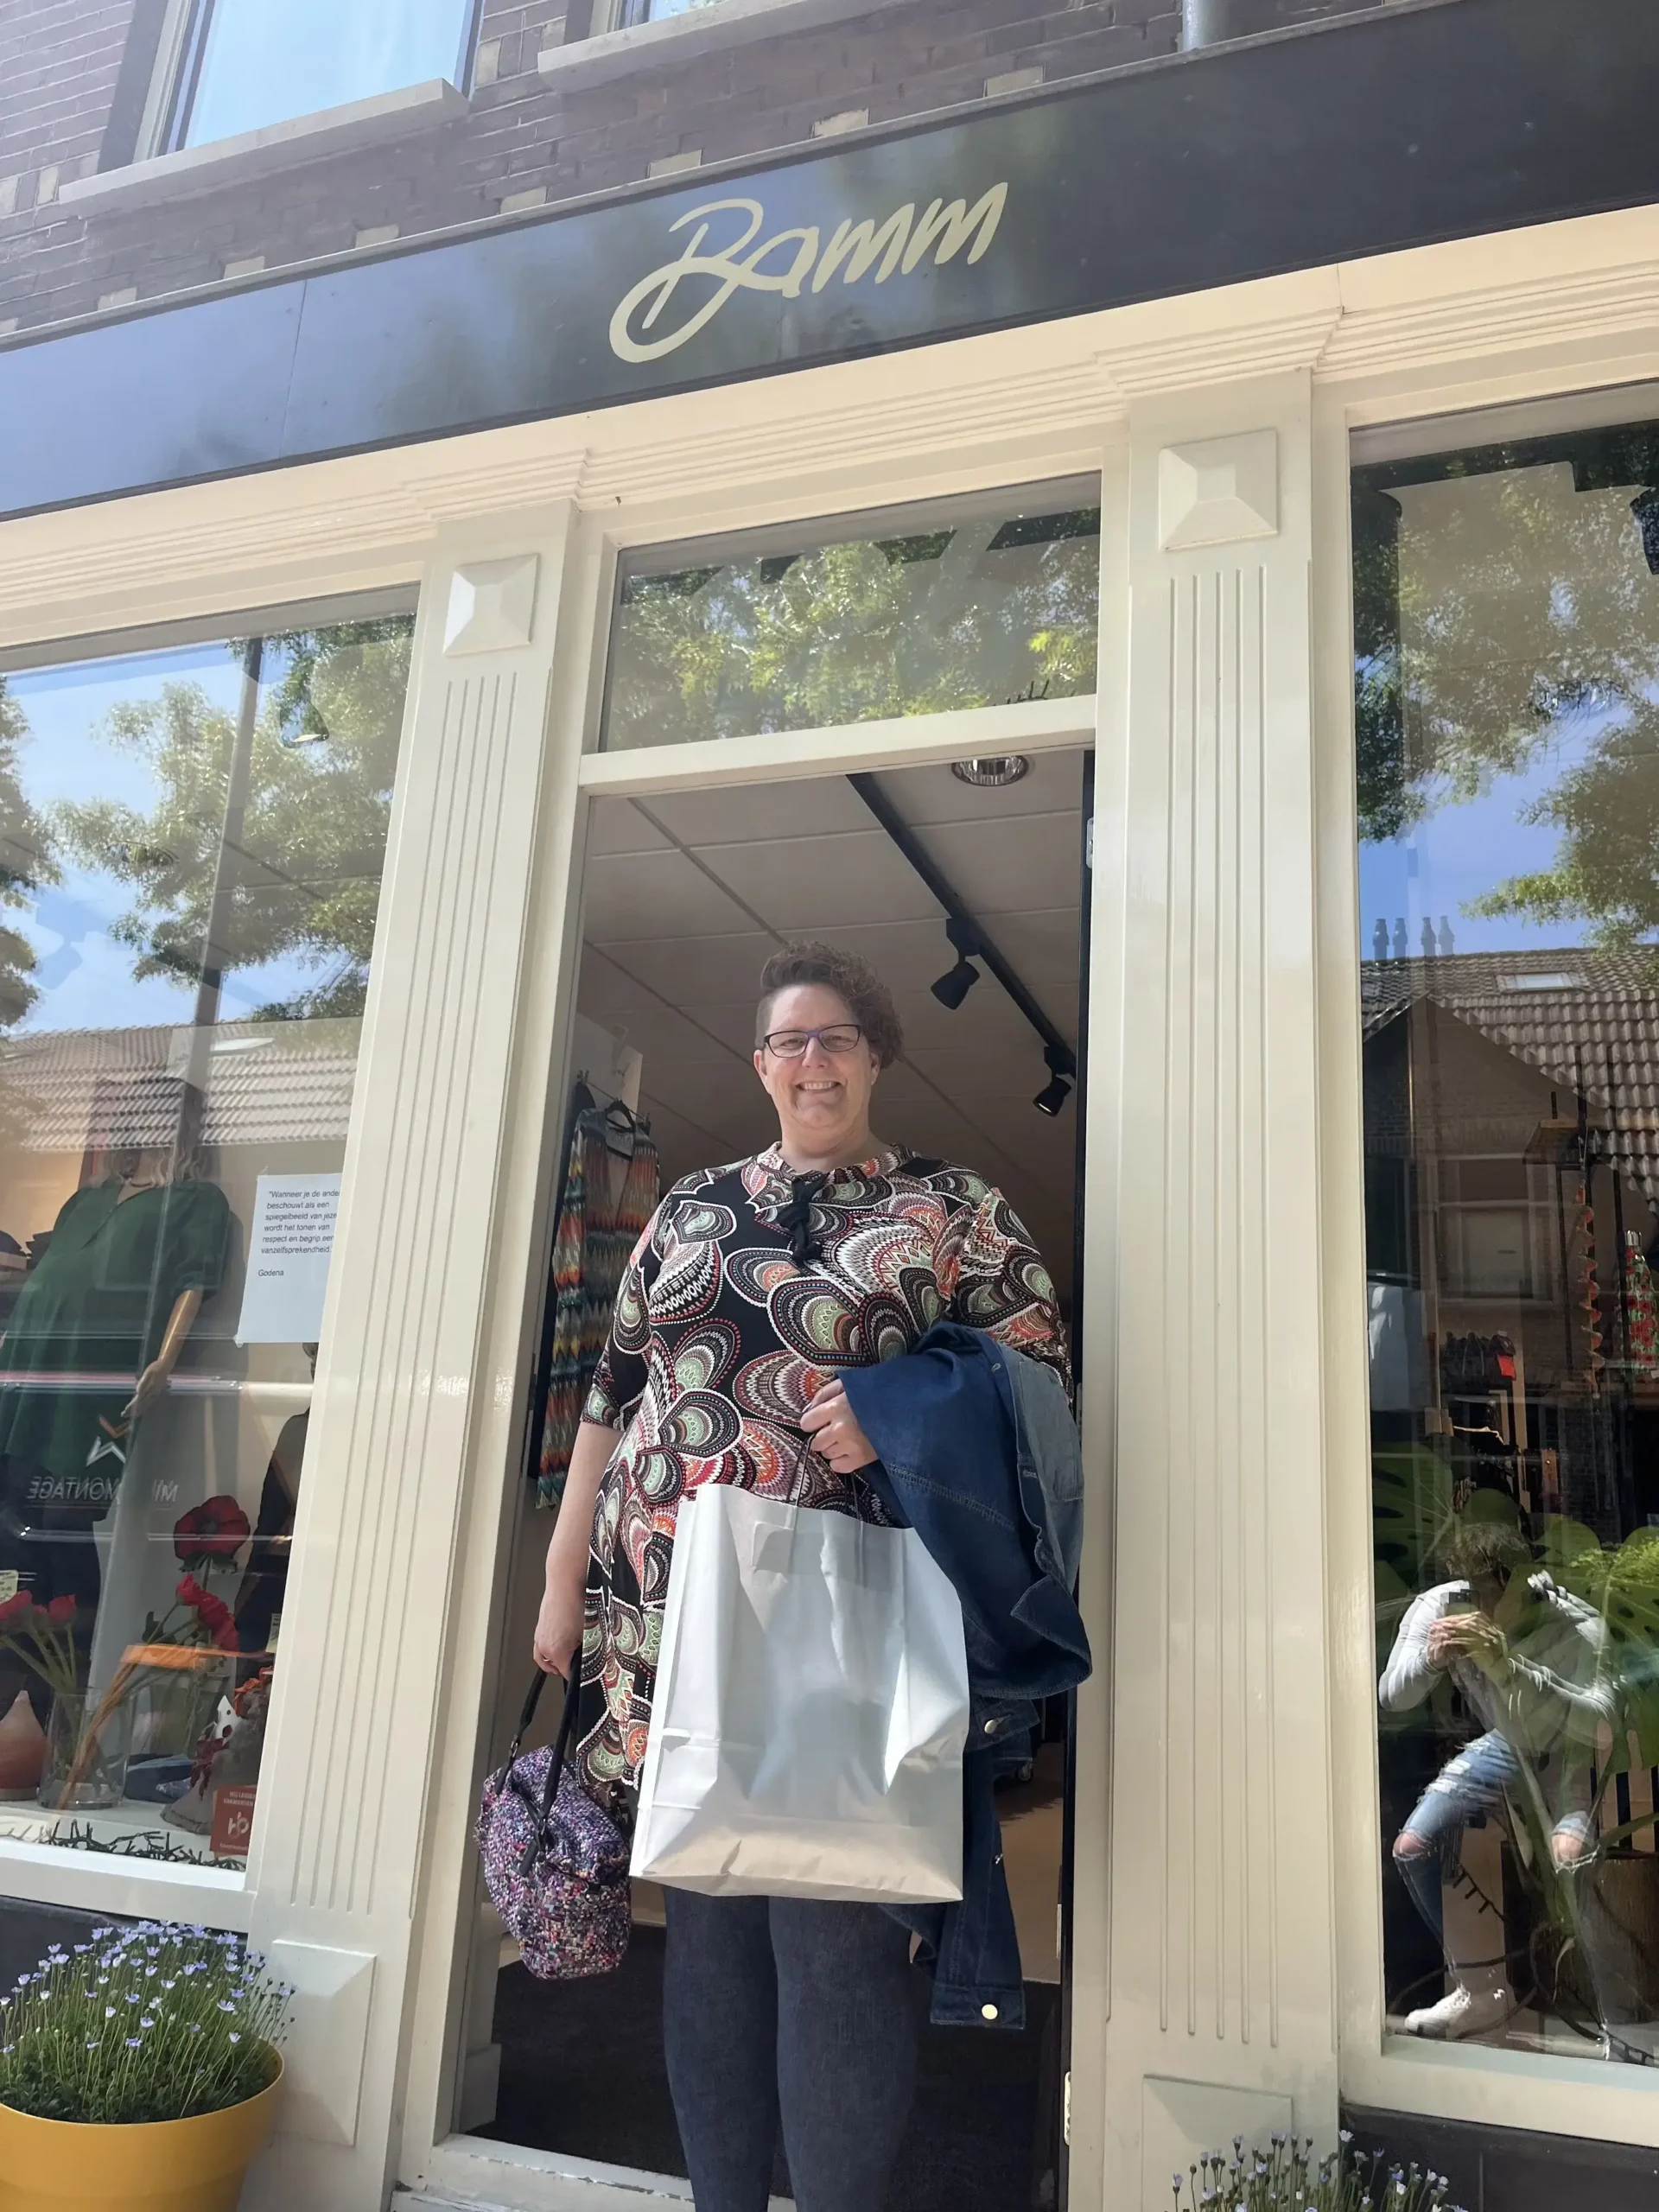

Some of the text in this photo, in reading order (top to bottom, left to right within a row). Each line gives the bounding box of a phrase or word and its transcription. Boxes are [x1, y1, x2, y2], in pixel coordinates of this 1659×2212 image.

[609, 181, 1008, 363] Bamm
[269, 1190, 302, 1198] "Wanneer
[302, 1191, 310, 1199] je
[265, 1212, 308, 1222] spiegelbeeld
[262, 1236, 288, 1244] respect
[299, 1236, 321, 1244] begrip
[257, 1268, 284, 1277] Godena
